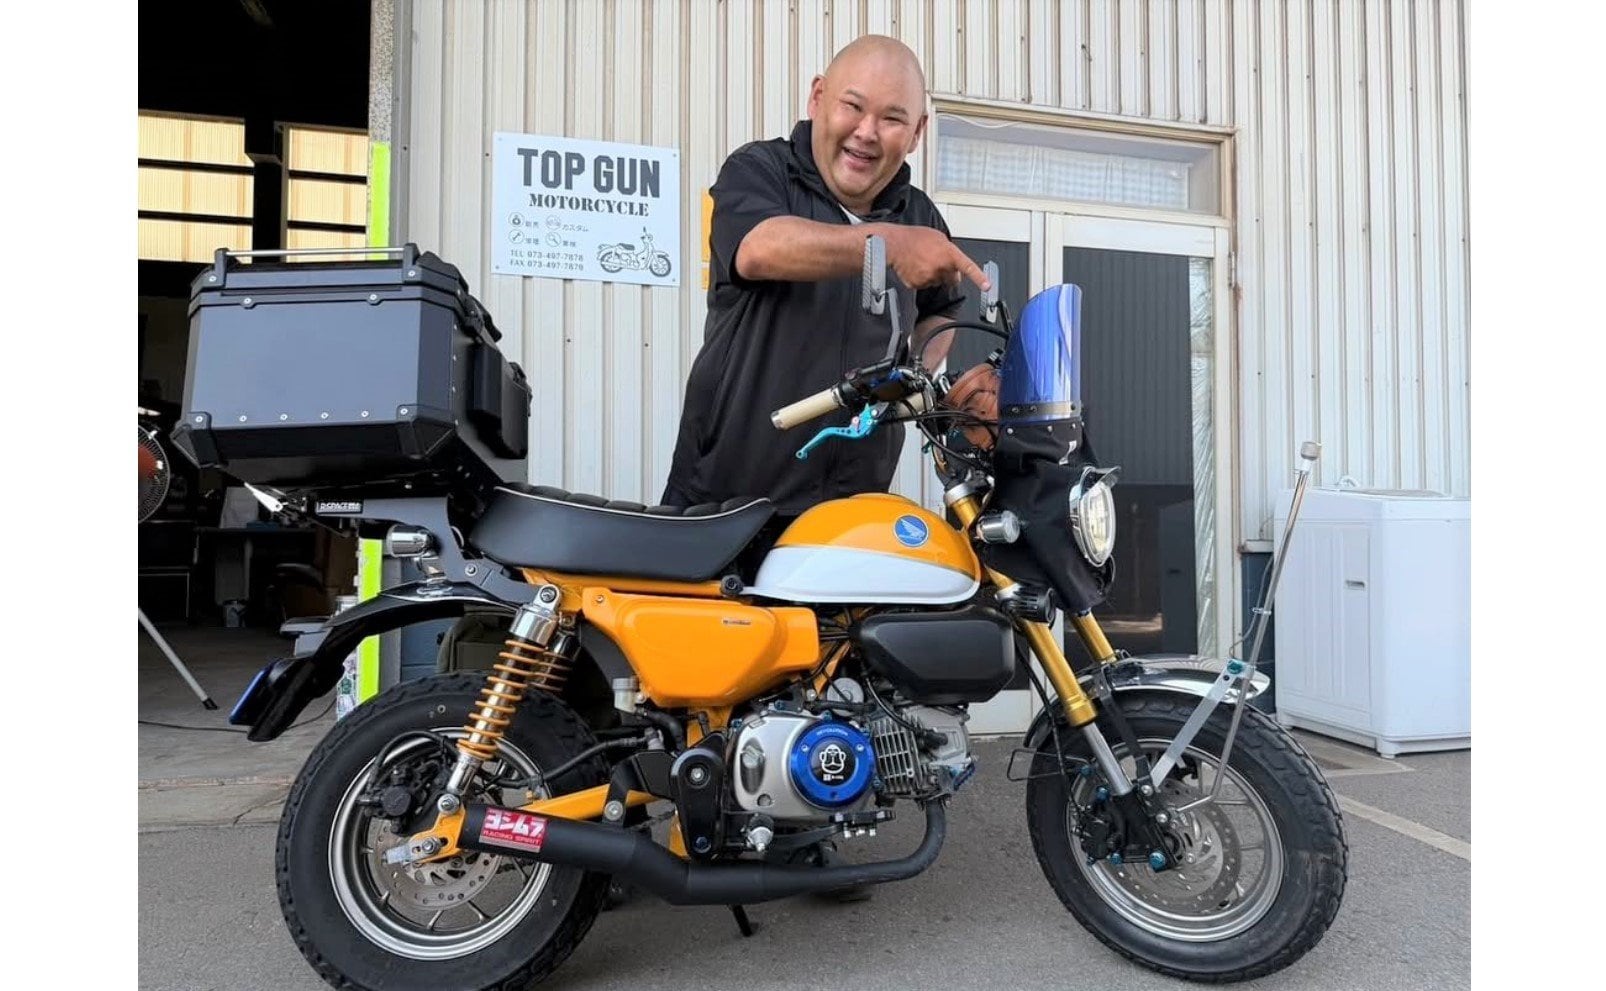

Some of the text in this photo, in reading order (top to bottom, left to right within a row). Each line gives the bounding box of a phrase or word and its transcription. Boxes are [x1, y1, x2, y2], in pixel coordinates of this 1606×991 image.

[517, 147, 660, 198] TOP GUN
[529, 193, 649, 217] MOTORCYCLE
[510, 249, 524, 257] TEL
[510, 259, 525, 267] FAX
[484, 808, 547, 837] ヨシムラ
[483, 830, 514, 840] RACING
